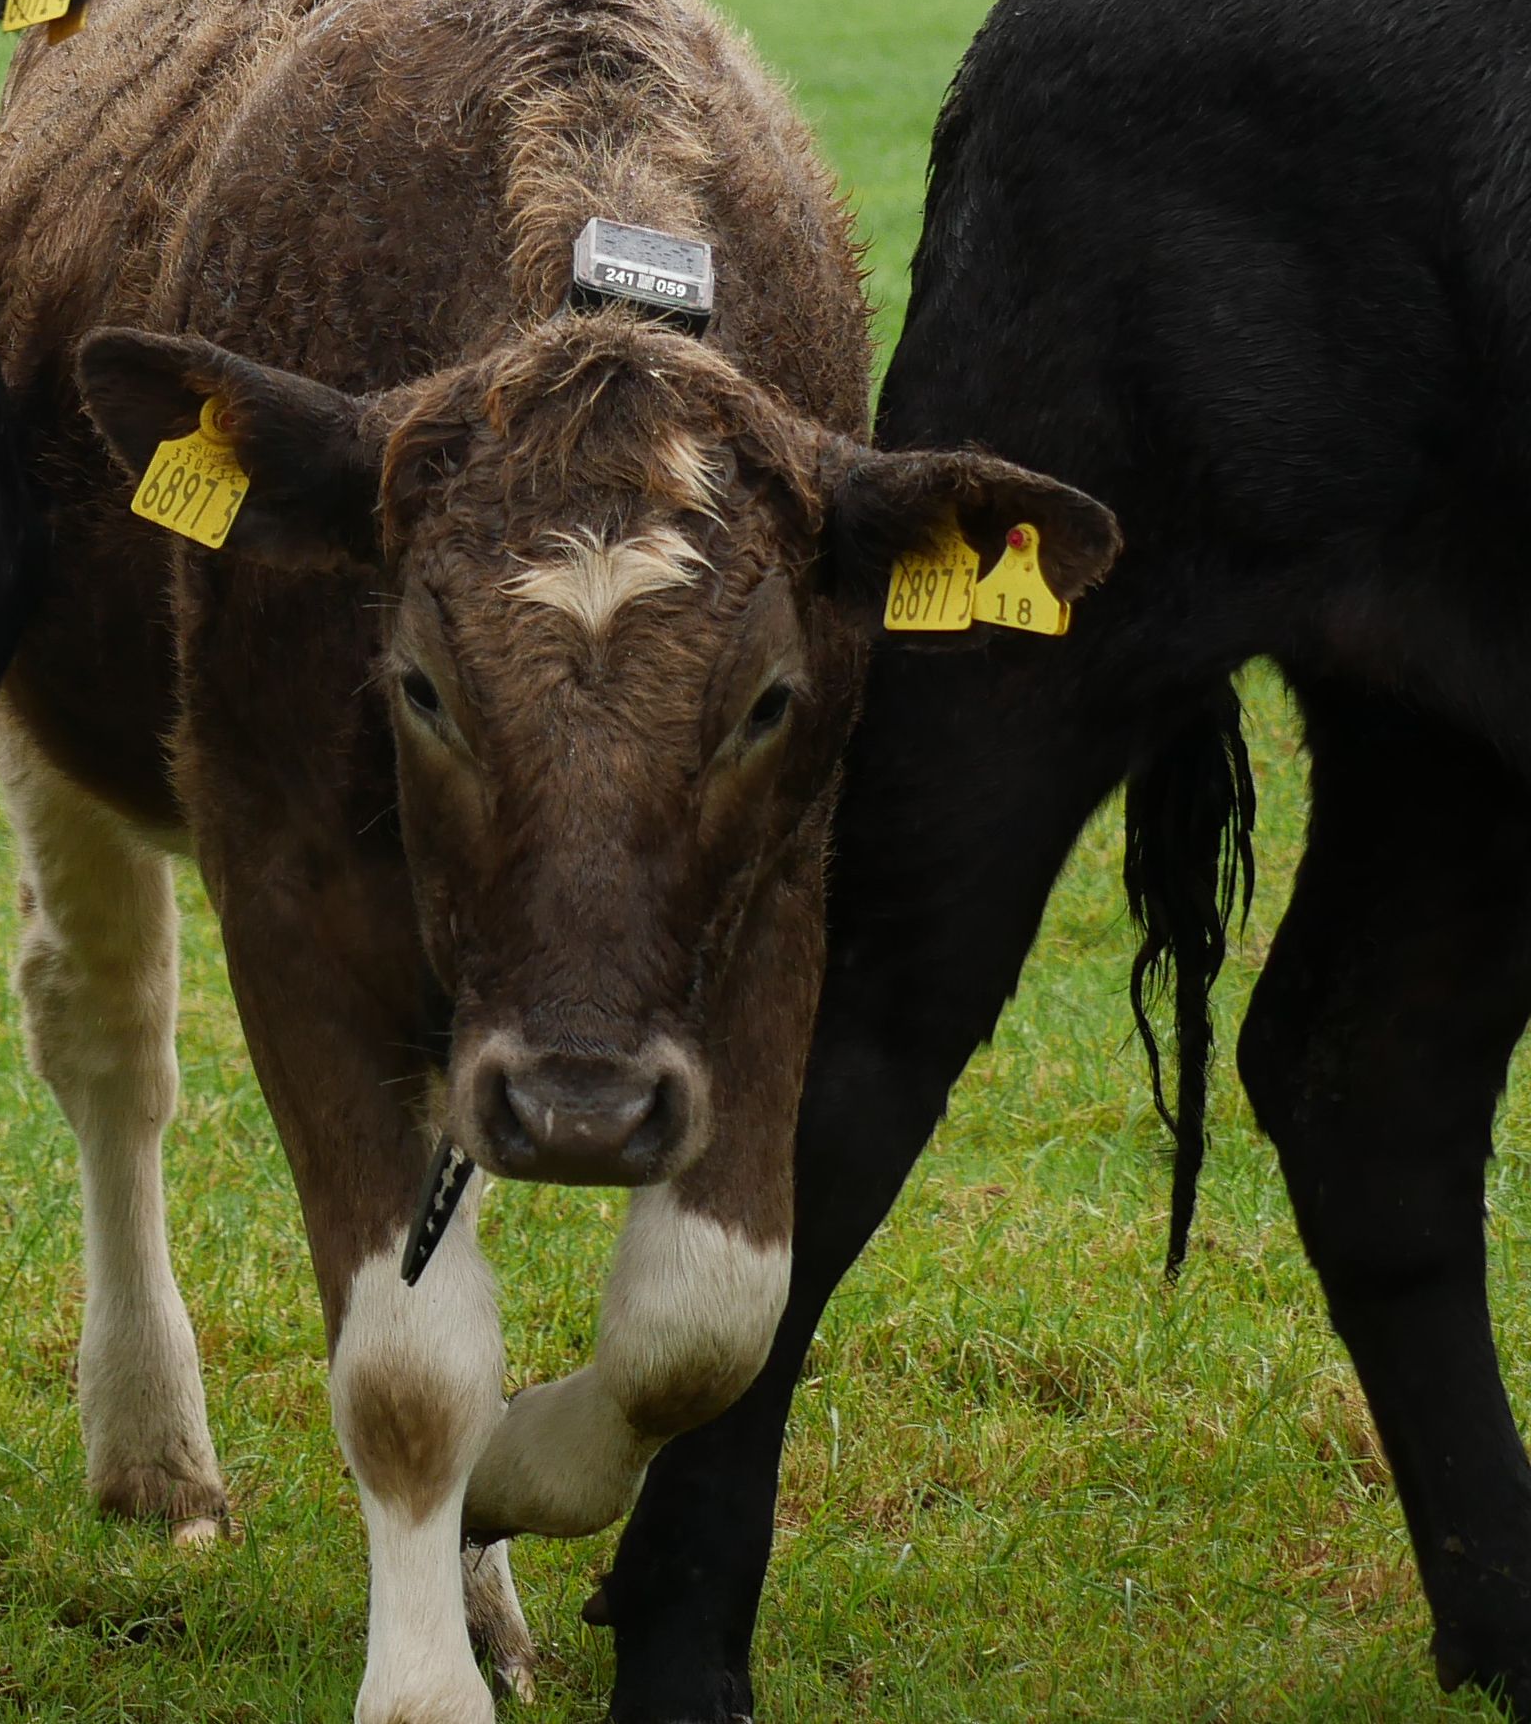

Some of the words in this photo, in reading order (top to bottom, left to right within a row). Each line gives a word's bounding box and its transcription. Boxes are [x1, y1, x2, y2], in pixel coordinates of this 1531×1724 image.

[604, 267, 634, 287] 241
[656, 278, 687, 298] 059
[141, 460, 219, 530] 6897
[890, 568, 954, 622] 6897
